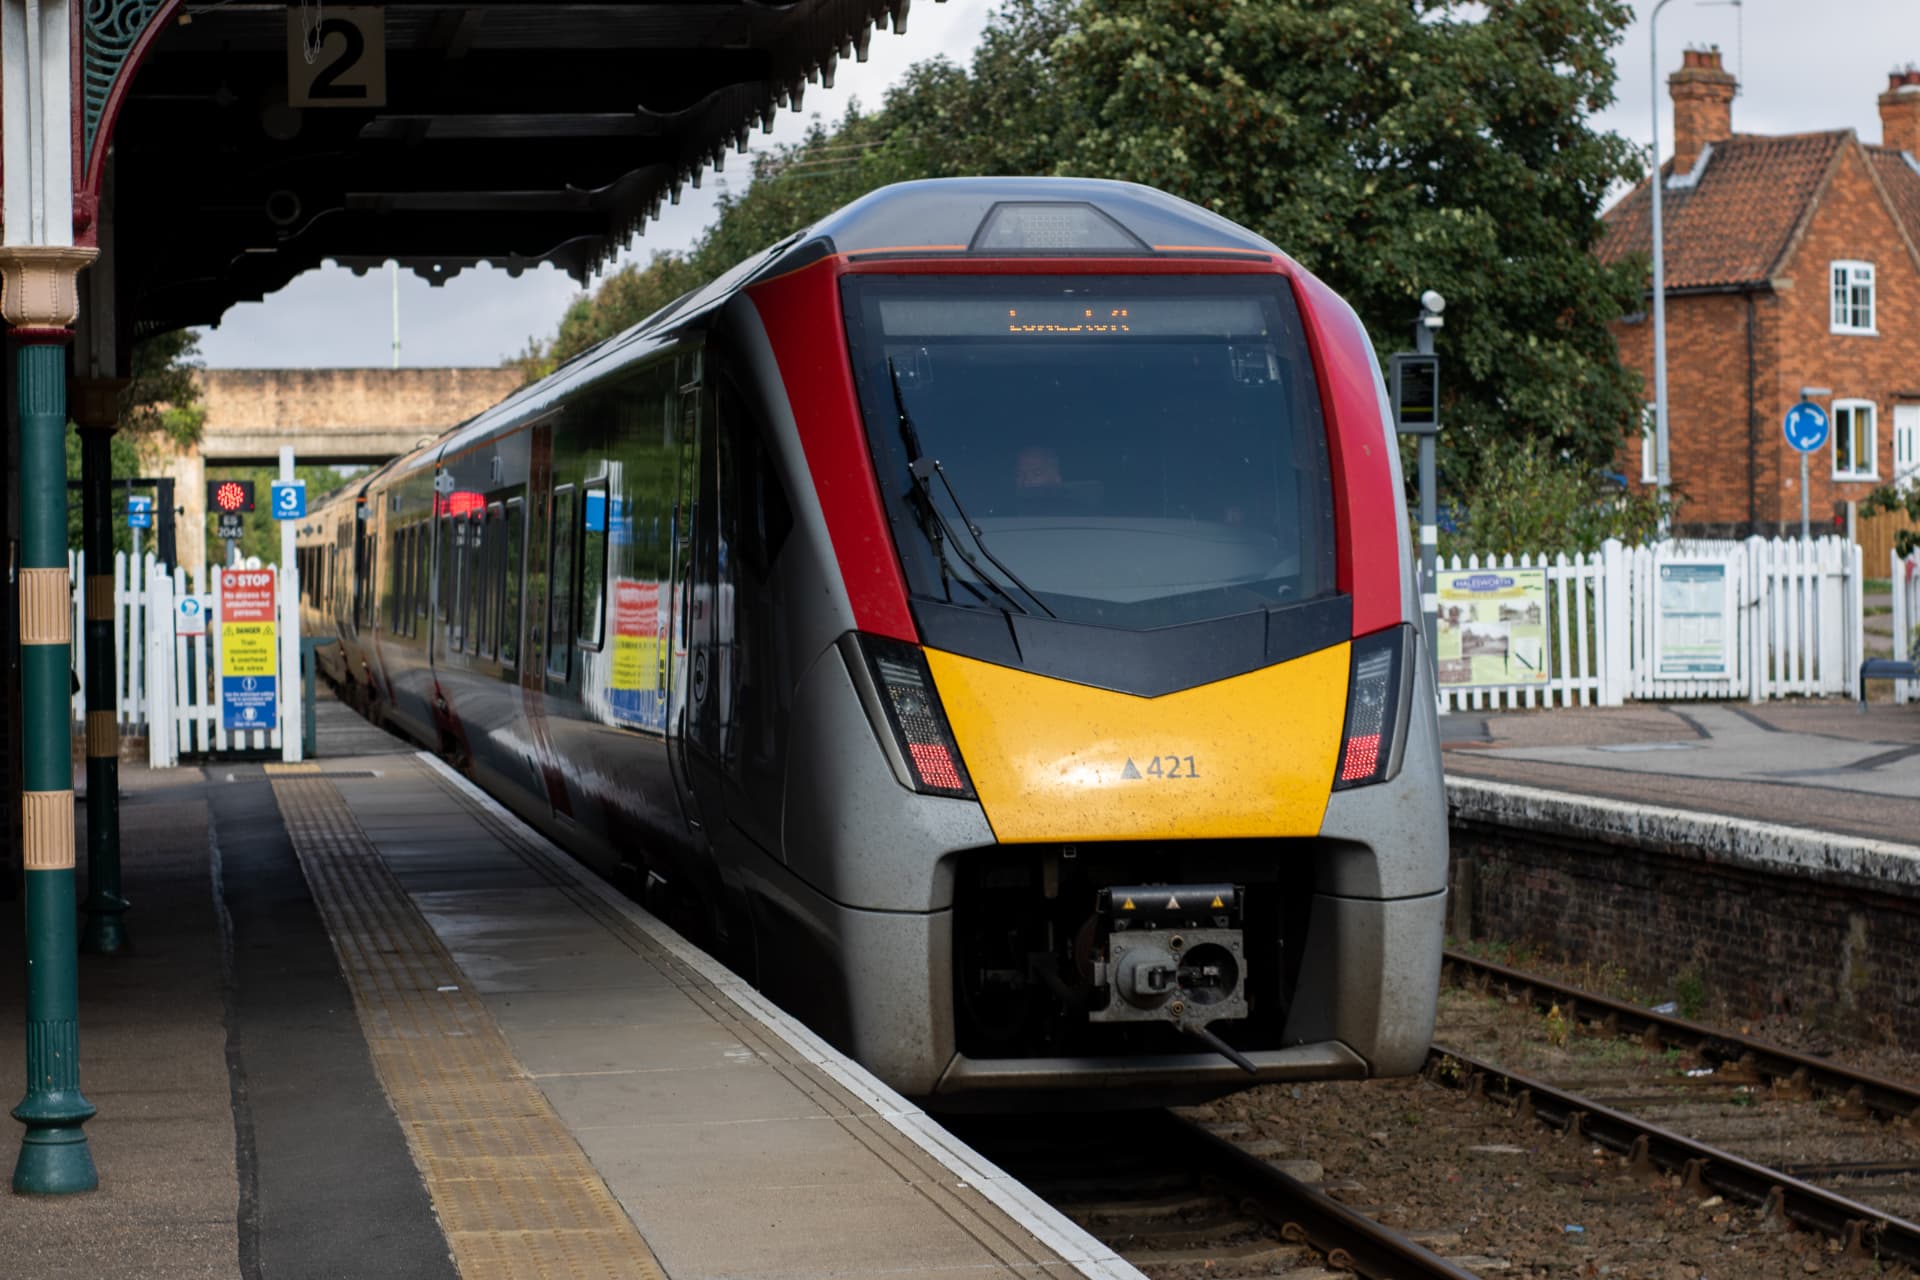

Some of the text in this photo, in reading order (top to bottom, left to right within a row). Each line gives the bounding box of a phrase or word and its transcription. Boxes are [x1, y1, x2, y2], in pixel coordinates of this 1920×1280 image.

[307, 18, 368, 99] 2
[280, 487, 298, 511] 3
[134, 503, 145, 521] 4
[237, 574, 270, 587] STOP
[1455, 578, 1512, 588] HALESWORTH
[1146, 755, 1200, 778] 421
